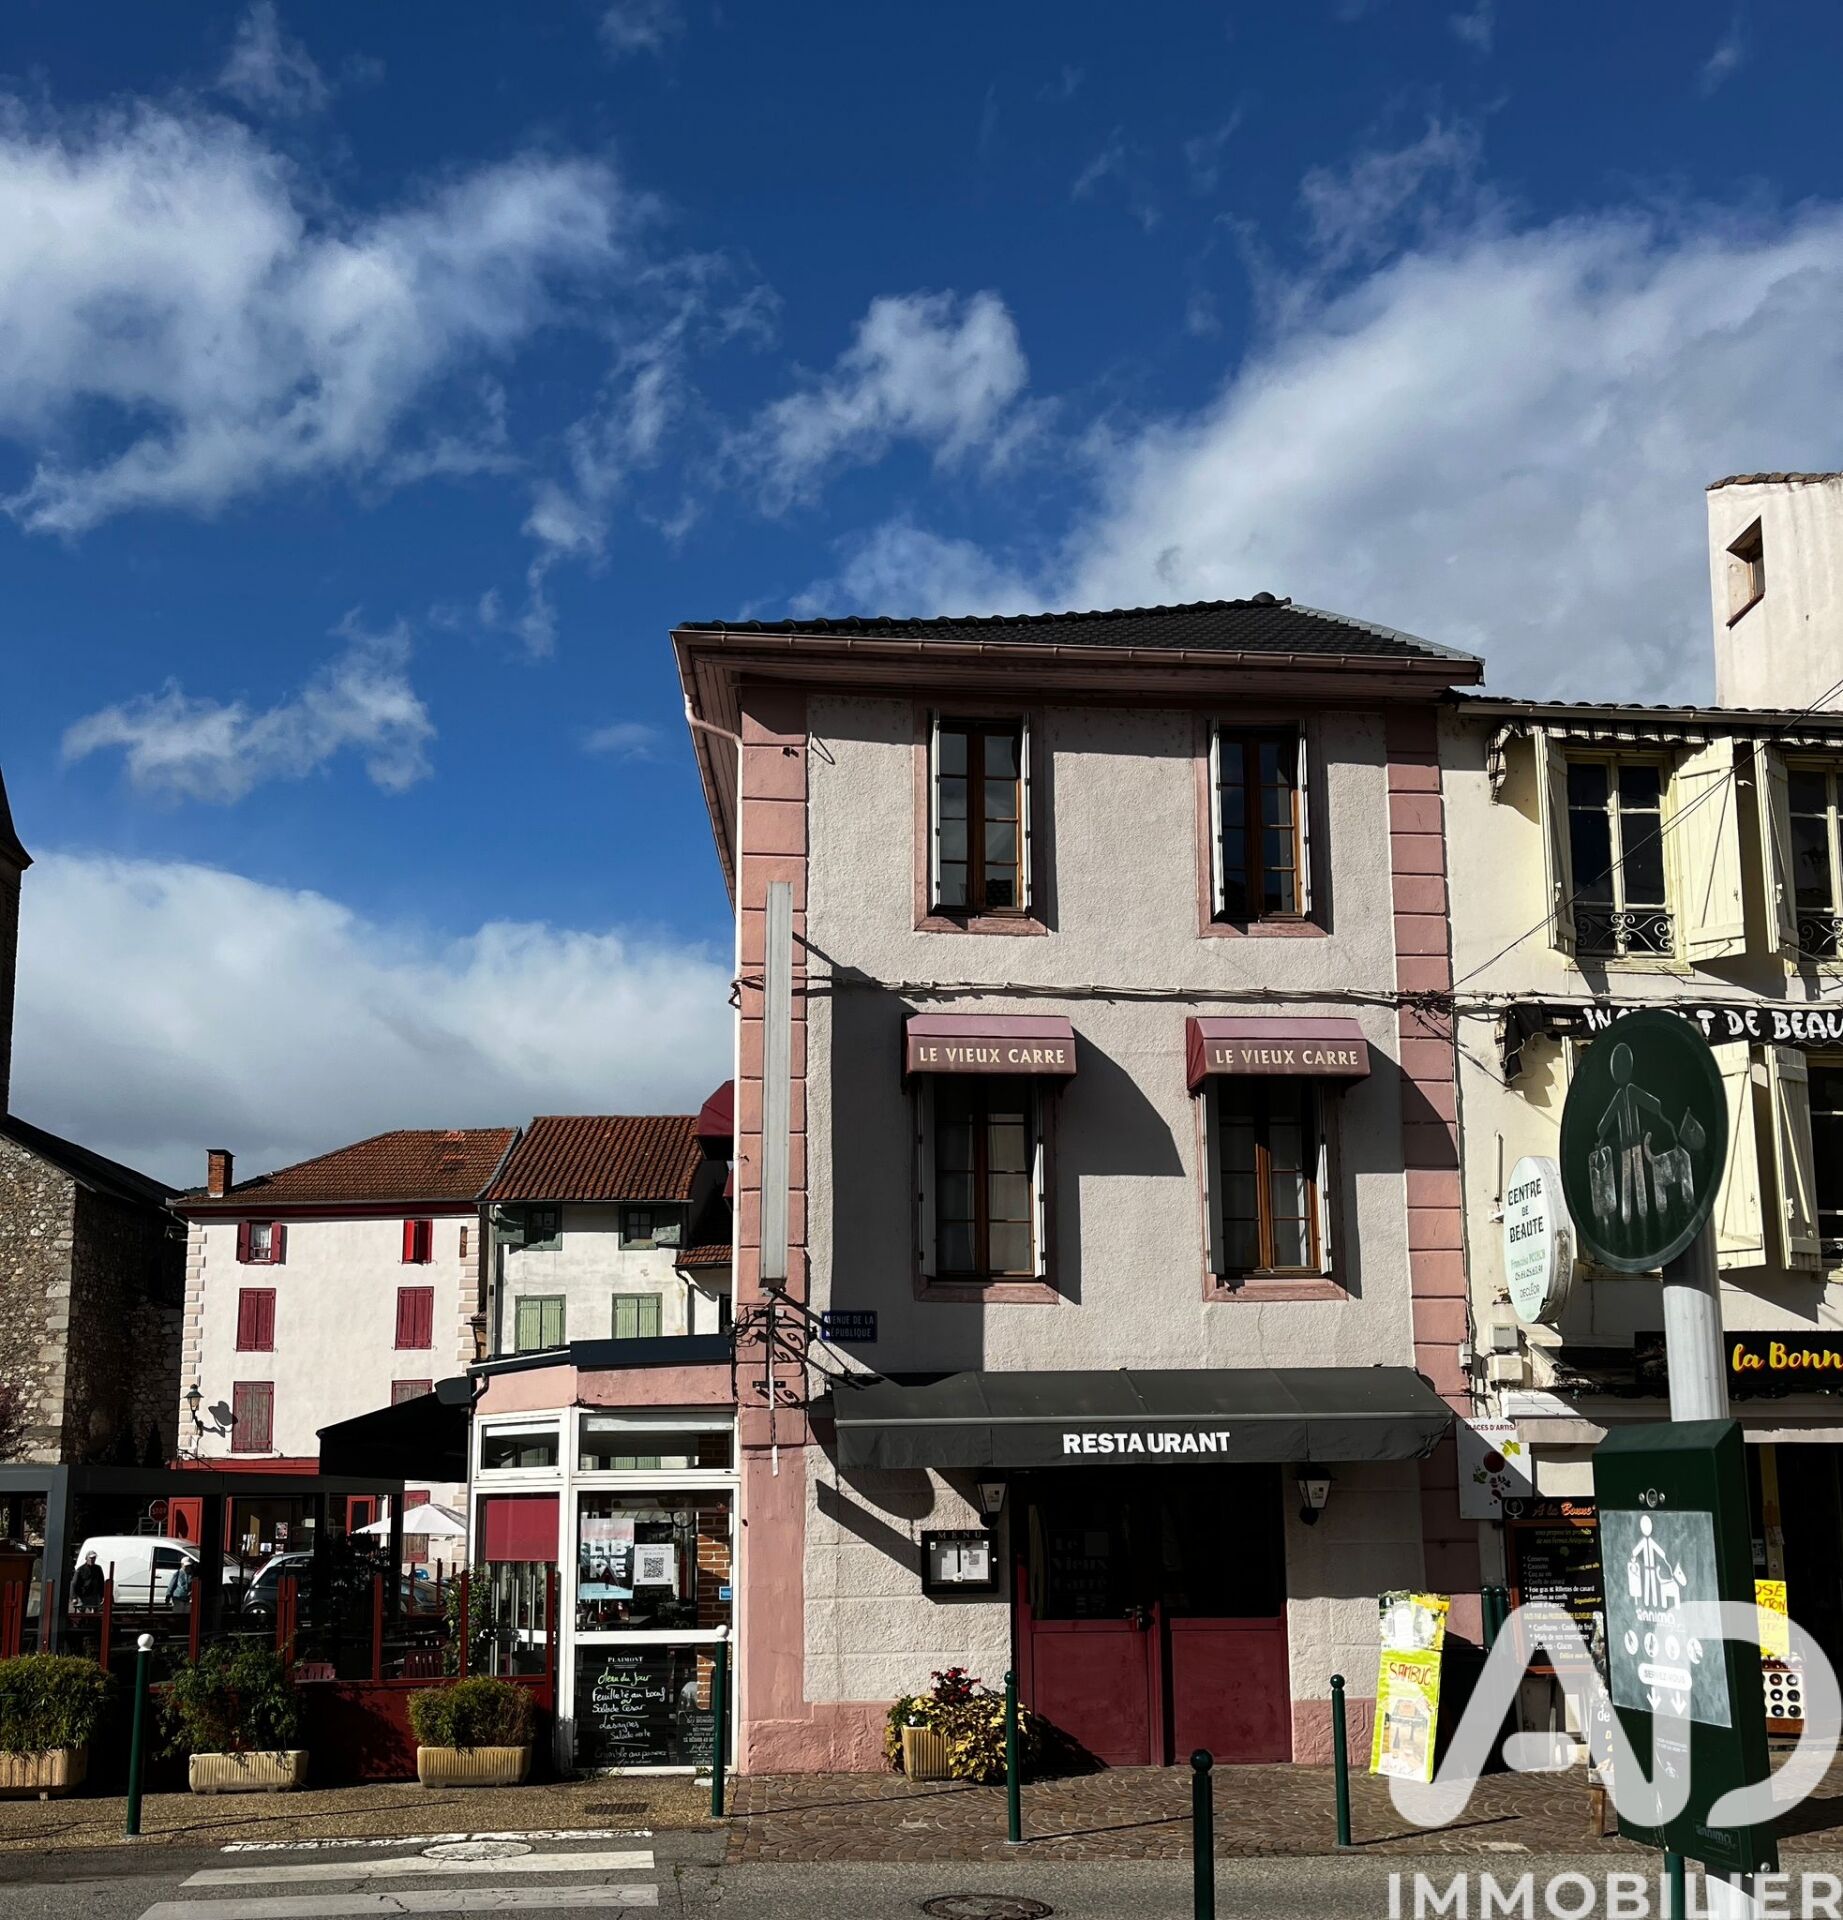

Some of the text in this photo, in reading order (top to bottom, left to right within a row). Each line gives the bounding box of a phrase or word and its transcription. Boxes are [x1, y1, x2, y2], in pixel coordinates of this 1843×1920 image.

[1724, 1010, 1761, 1036] DE
[919, 1047, 1066, 1064] LE VIEUX CARRE
[1215, 1049, 1359, 1066] LE VIEUX CARRE
[1508, 1177, 1542, 1206] CENTRE
[1521, 1205, 1529, 1216] DE
[1509, 1215, 1544, 1243] BEAUTE
[824, 1315, 875, 1325] AVENUE DE LA
[1063, 1431, 1231, 1454] RESTAURANT
[938, 1530, 982, 1540] MENU
[620, 1672, 631, 1682] du
[592, 1703, 620, 1713] Salade
